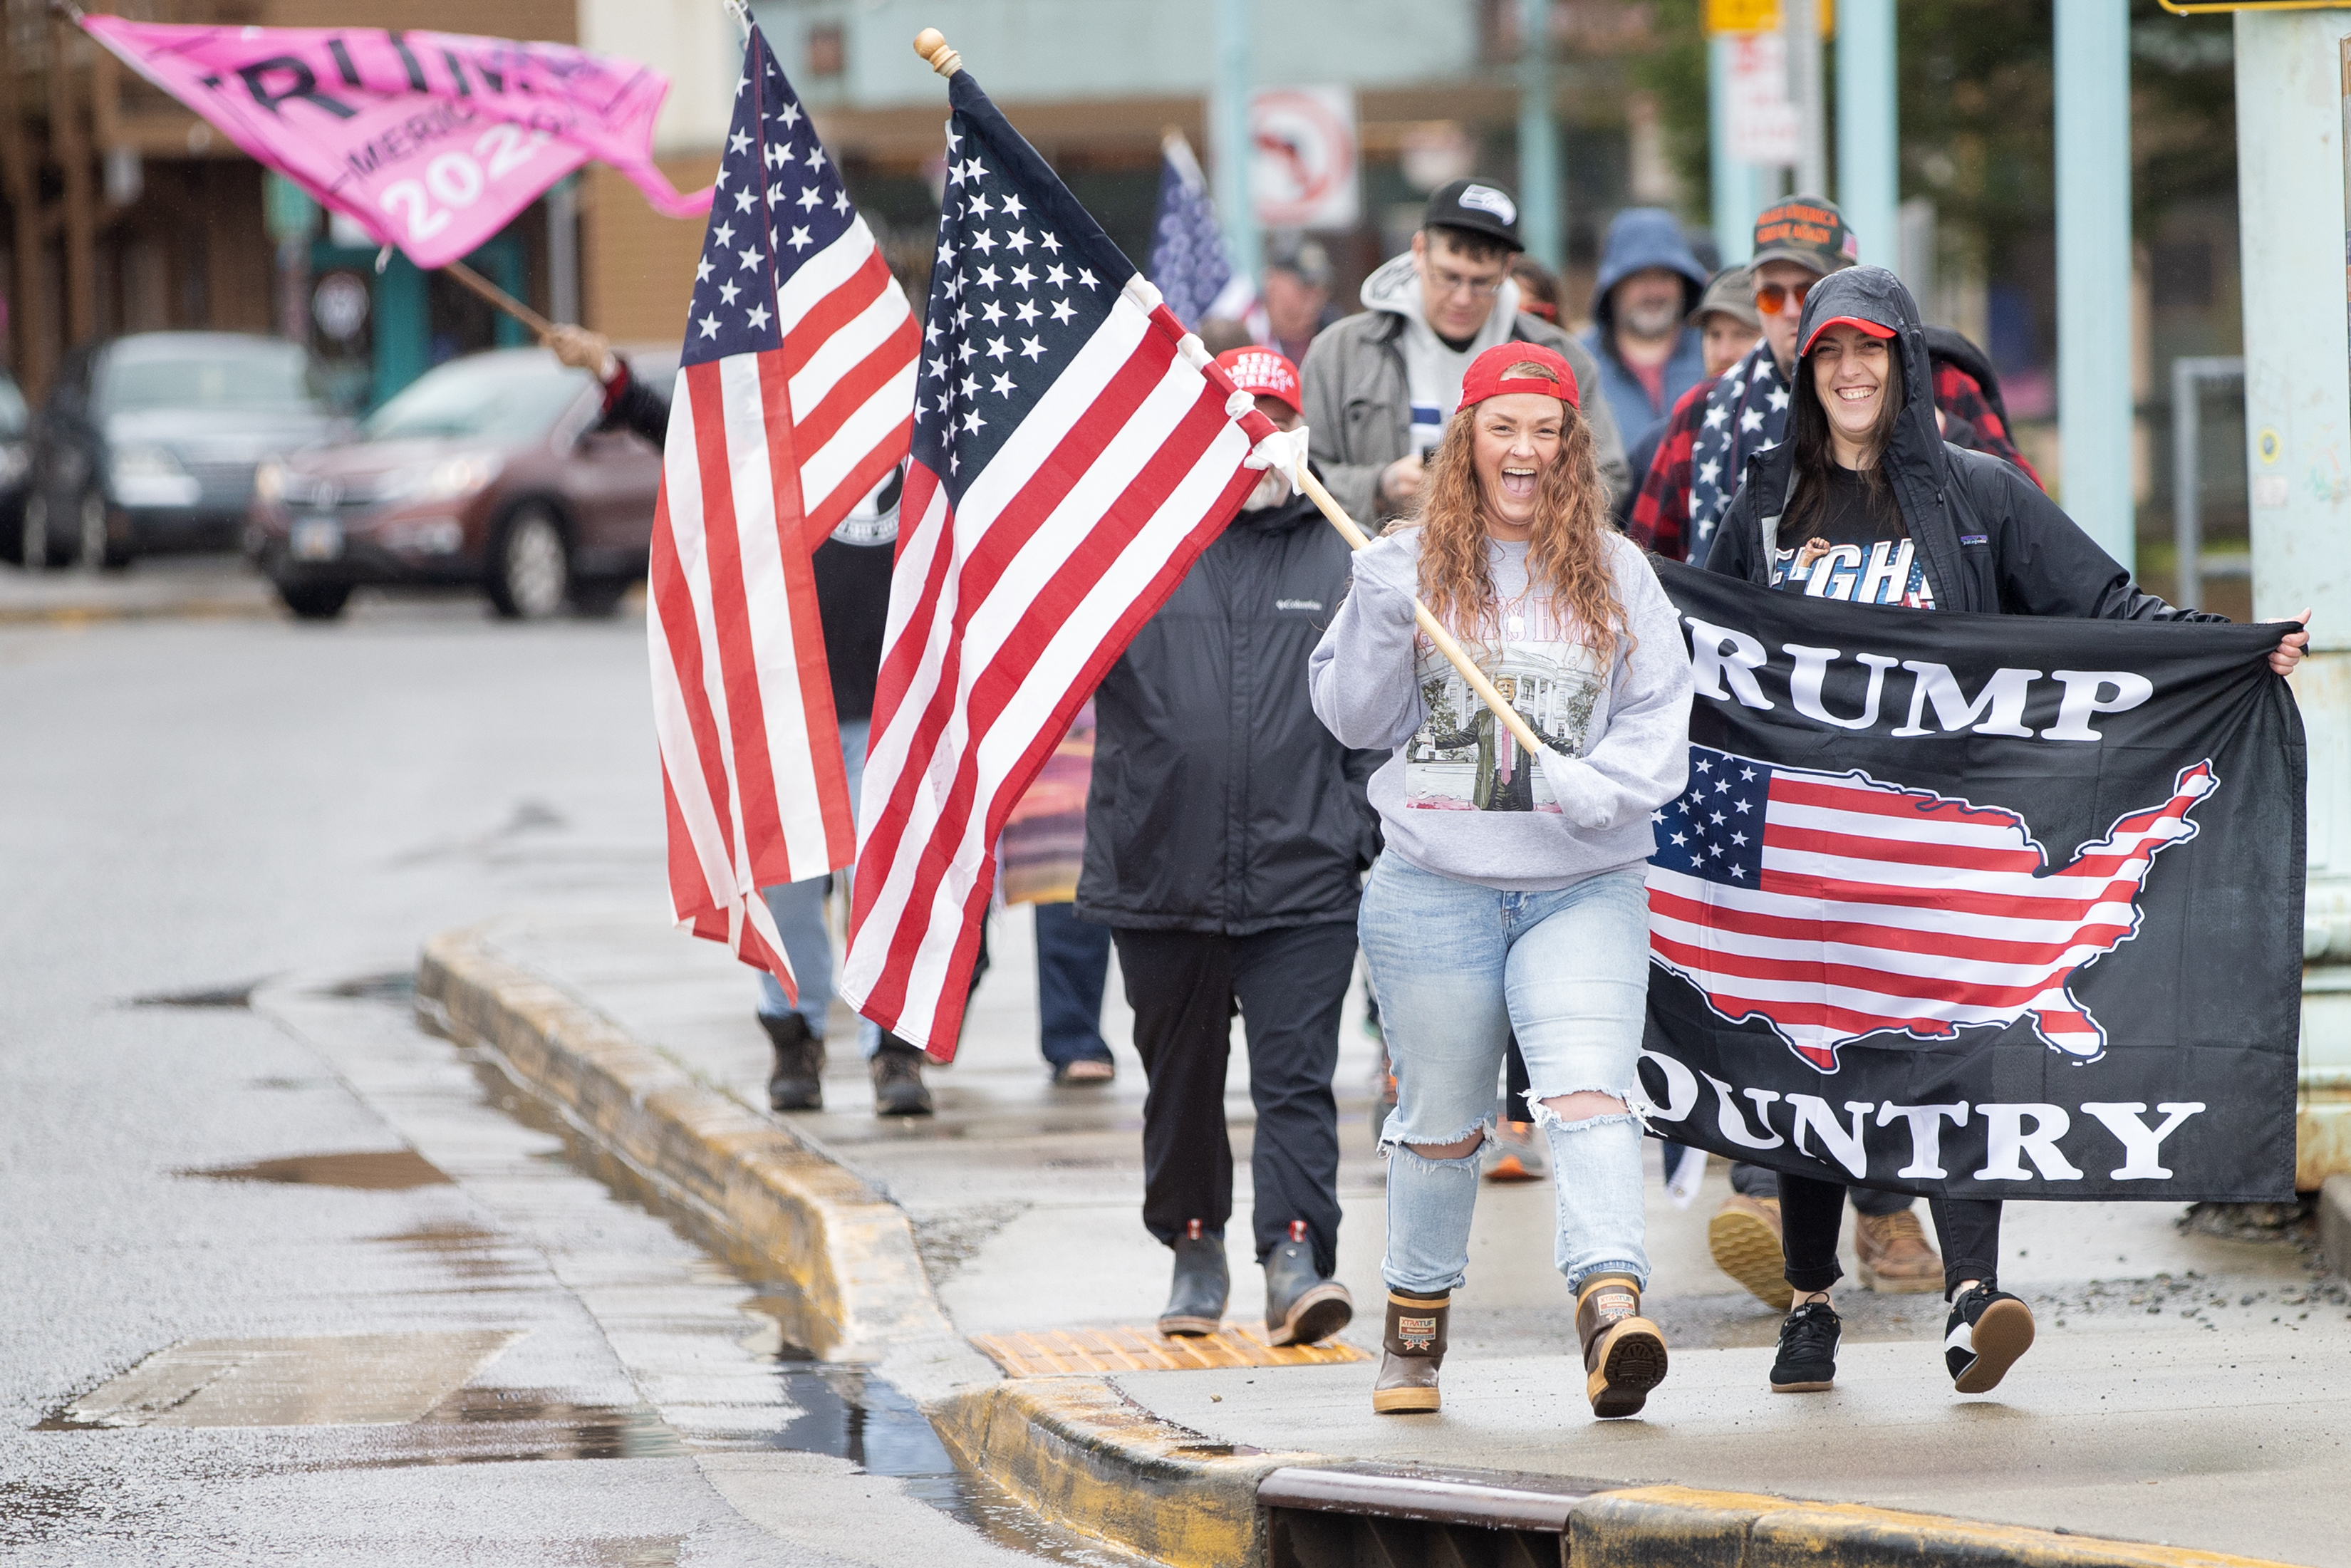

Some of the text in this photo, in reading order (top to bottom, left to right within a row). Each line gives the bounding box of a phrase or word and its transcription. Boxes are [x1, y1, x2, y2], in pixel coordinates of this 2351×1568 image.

[196, 30, 533, 121] RUM
[379, 125, 552, 244] 202
[1233, 374, 1287, 393] GREAT
[1237, 353, 1282, 367] KEEP
[1674, 608, 2153, 741] RUMP
[1631, 1047, 2206, 1181] OUNTRY
